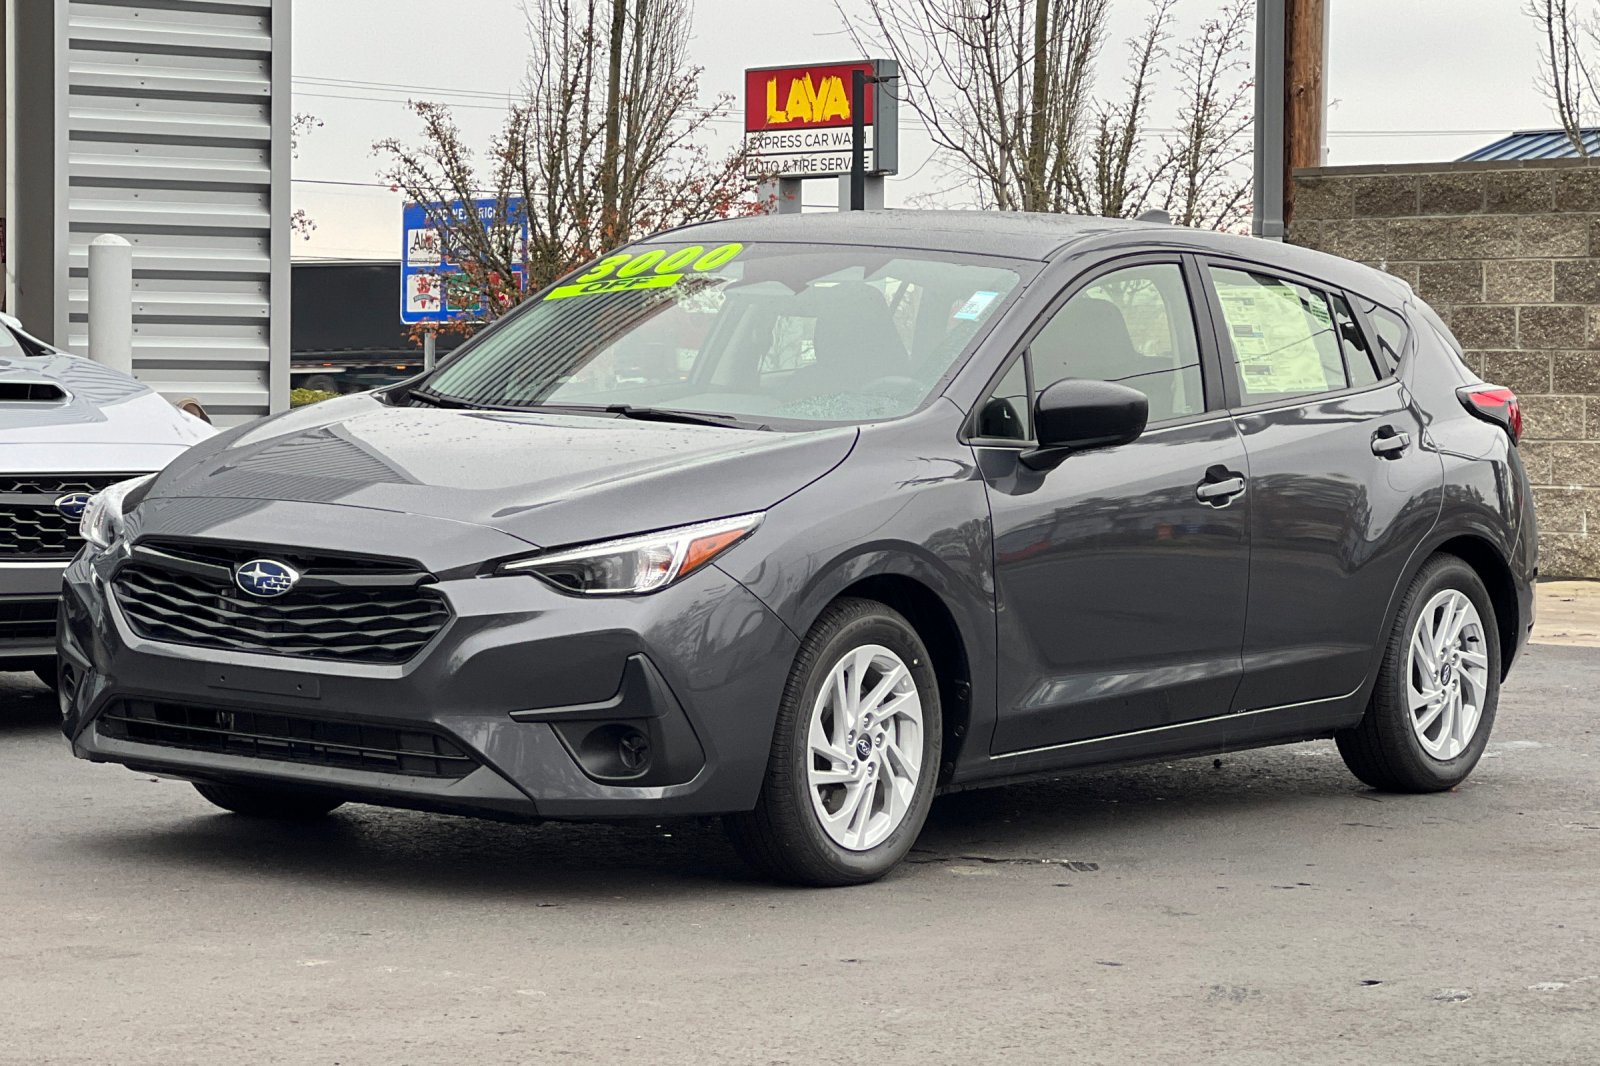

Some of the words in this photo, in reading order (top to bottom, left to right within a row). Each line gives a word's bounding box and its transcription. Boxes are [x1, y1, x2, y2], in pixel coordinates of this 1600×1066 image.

[767, 72, 850, 124] LAVA
[750, 134, 802, 149] EXPRESS
[805, 133, 829, 147] CAR
[831, 131, 867, 145] WA
[749, 160, 779, 174] AUTO
[782, 160, 791, 172] &
[792, 158, 817, 172] TIRE
[820, 156, 869, 171] SERVE
[576, 243, 744, 283] 3000
[580, 276, 654, 292] OFF
